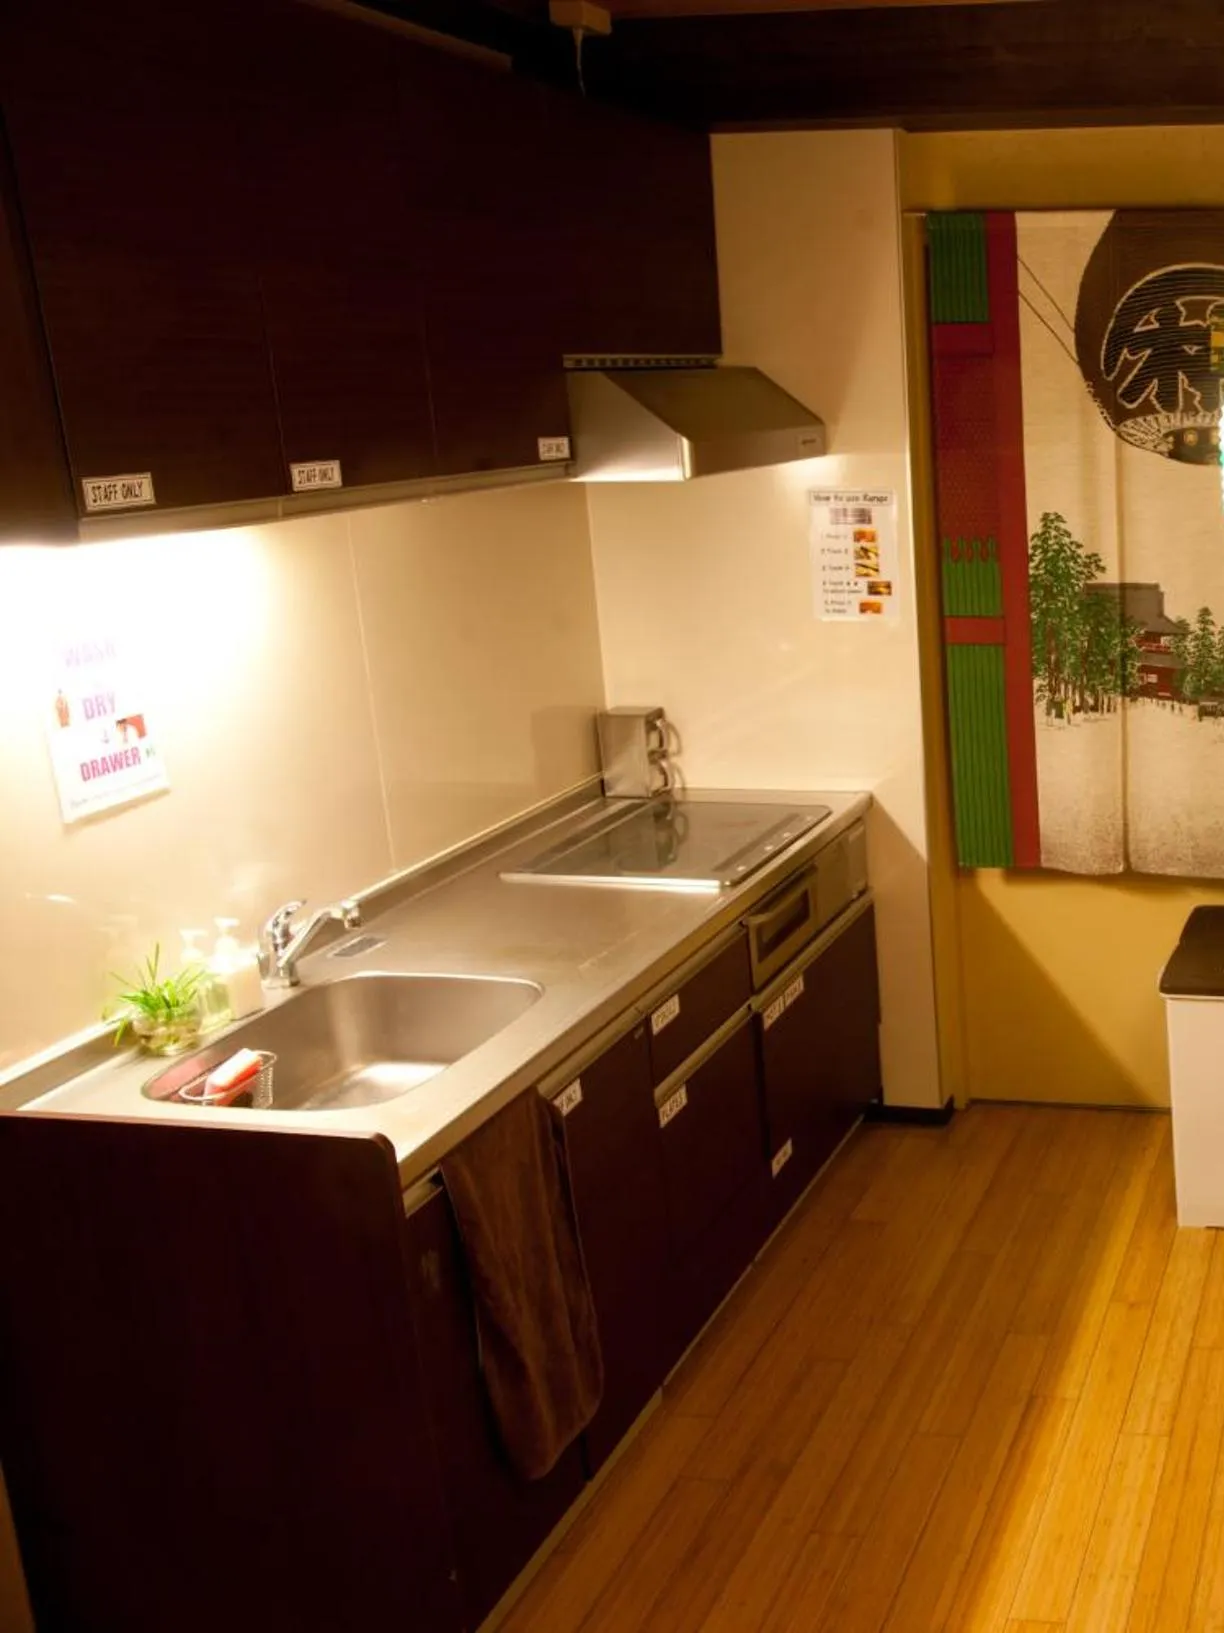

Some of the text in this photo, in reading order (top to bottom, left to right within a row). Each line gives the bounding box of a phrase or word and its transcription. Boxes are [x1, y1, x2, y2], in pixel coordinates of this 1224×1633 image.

[298, 467, 317, 484] STAFF
[91, 480, 143, 503] STAFF ONLY
[82, 691, 116, 720] DRY
[80, 746, 142, 782] DRAWER
